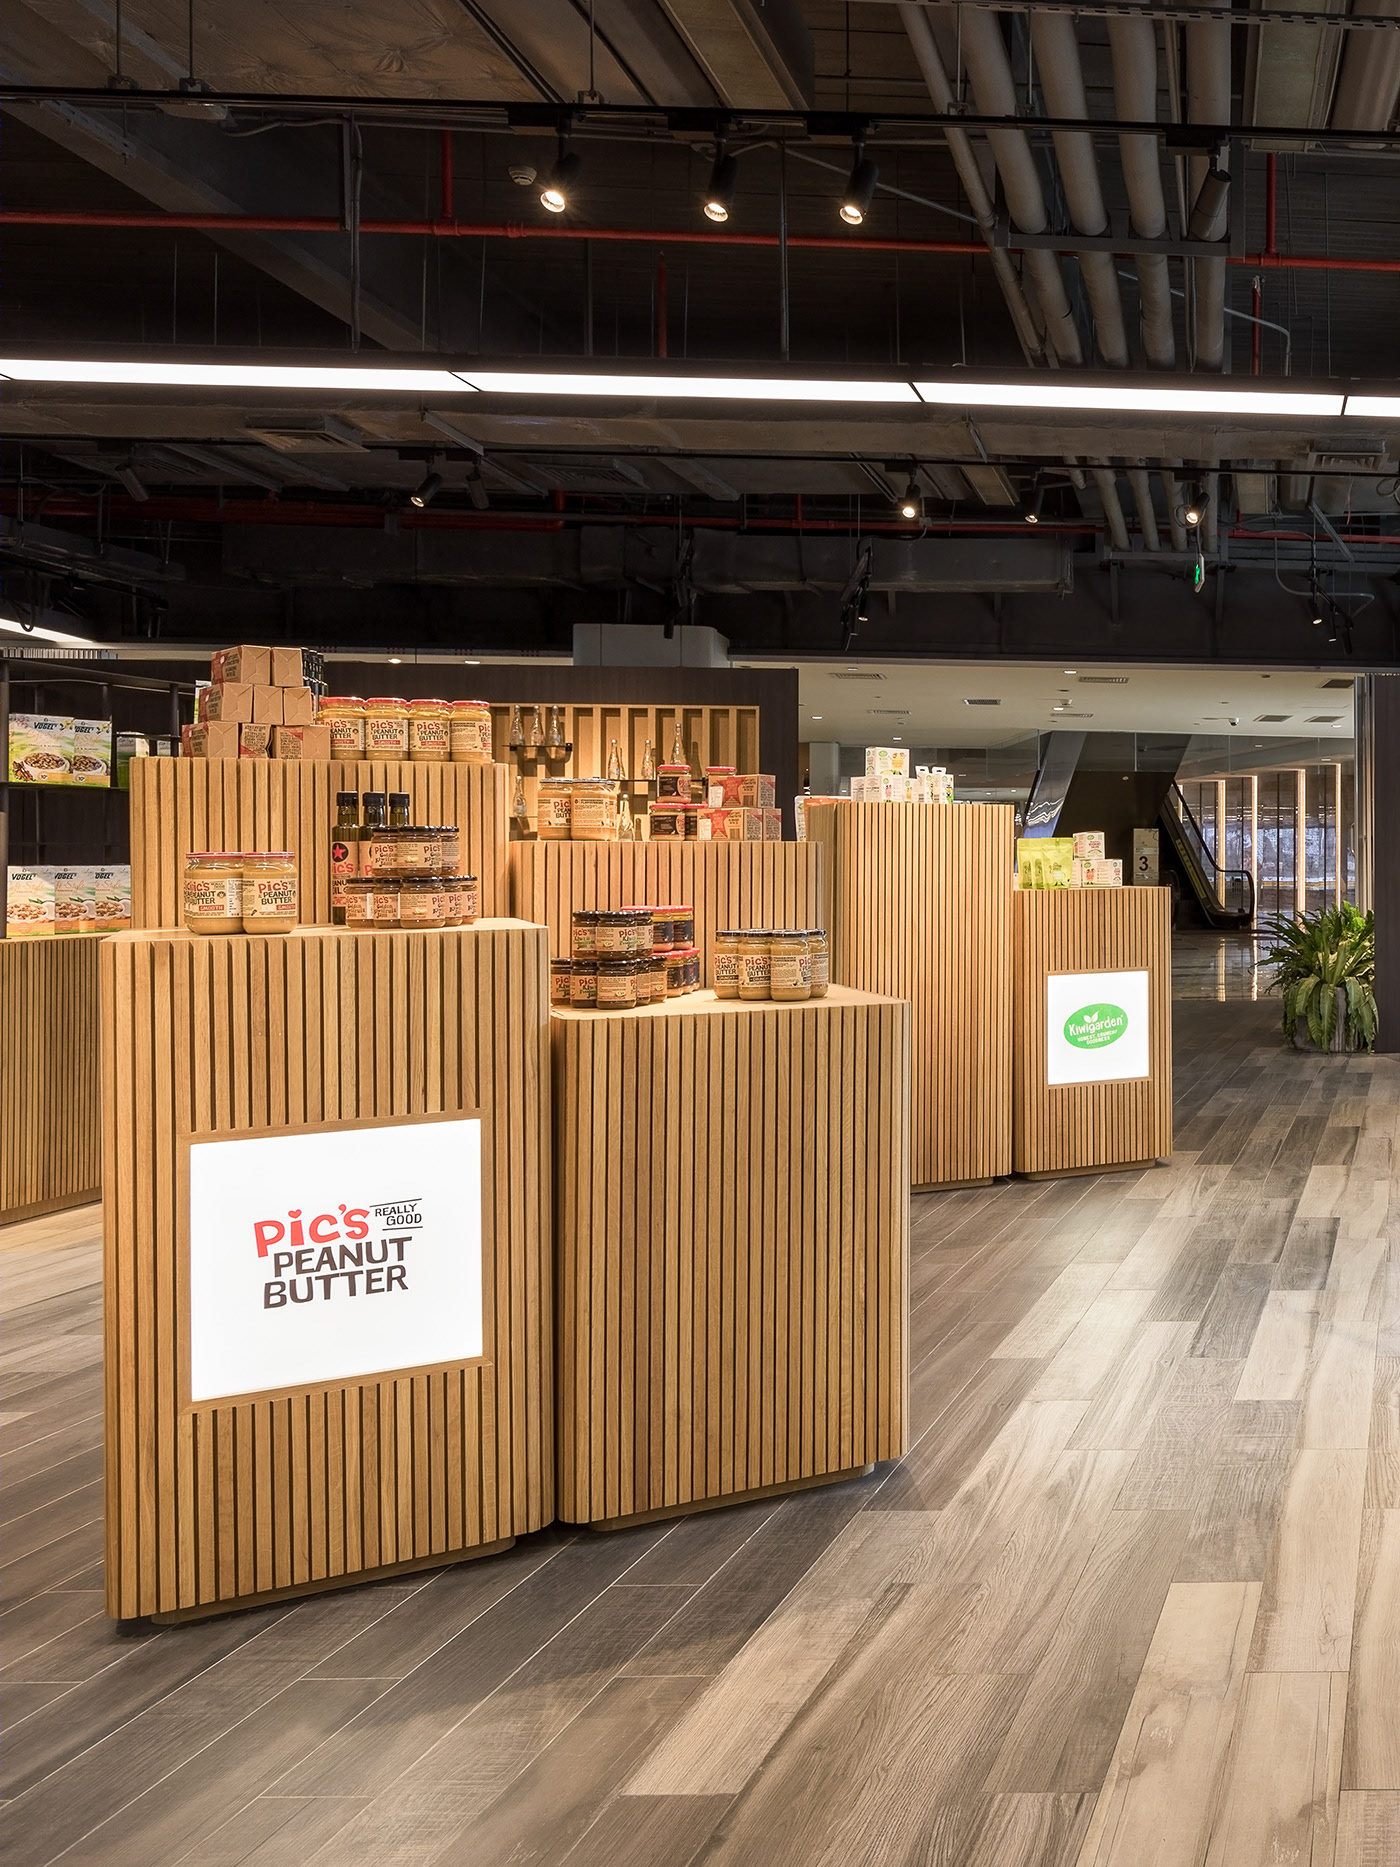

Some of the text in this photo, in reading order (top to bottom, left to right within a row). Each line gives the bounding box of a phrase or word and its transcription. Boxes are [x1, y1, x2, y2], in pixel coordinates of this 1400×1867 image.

[333, 863, 354, 874] ic's
[1139, 856, 1149, 872] 3
[261, 897, 292, 905] BUTTER
[263, 890, 293, 899] PEANUT
[1068, 1015, 1123, 1036] Kiwigarden
[374, 1203, 418, 1218] REALLY
[386, 1213, 422, 1227] GOOD
[254, 1204, 370, 1258] Pic's
[273, 1236, 413, 1278] PEANUT
[264, 1264, 410, 1310] BUTTER
